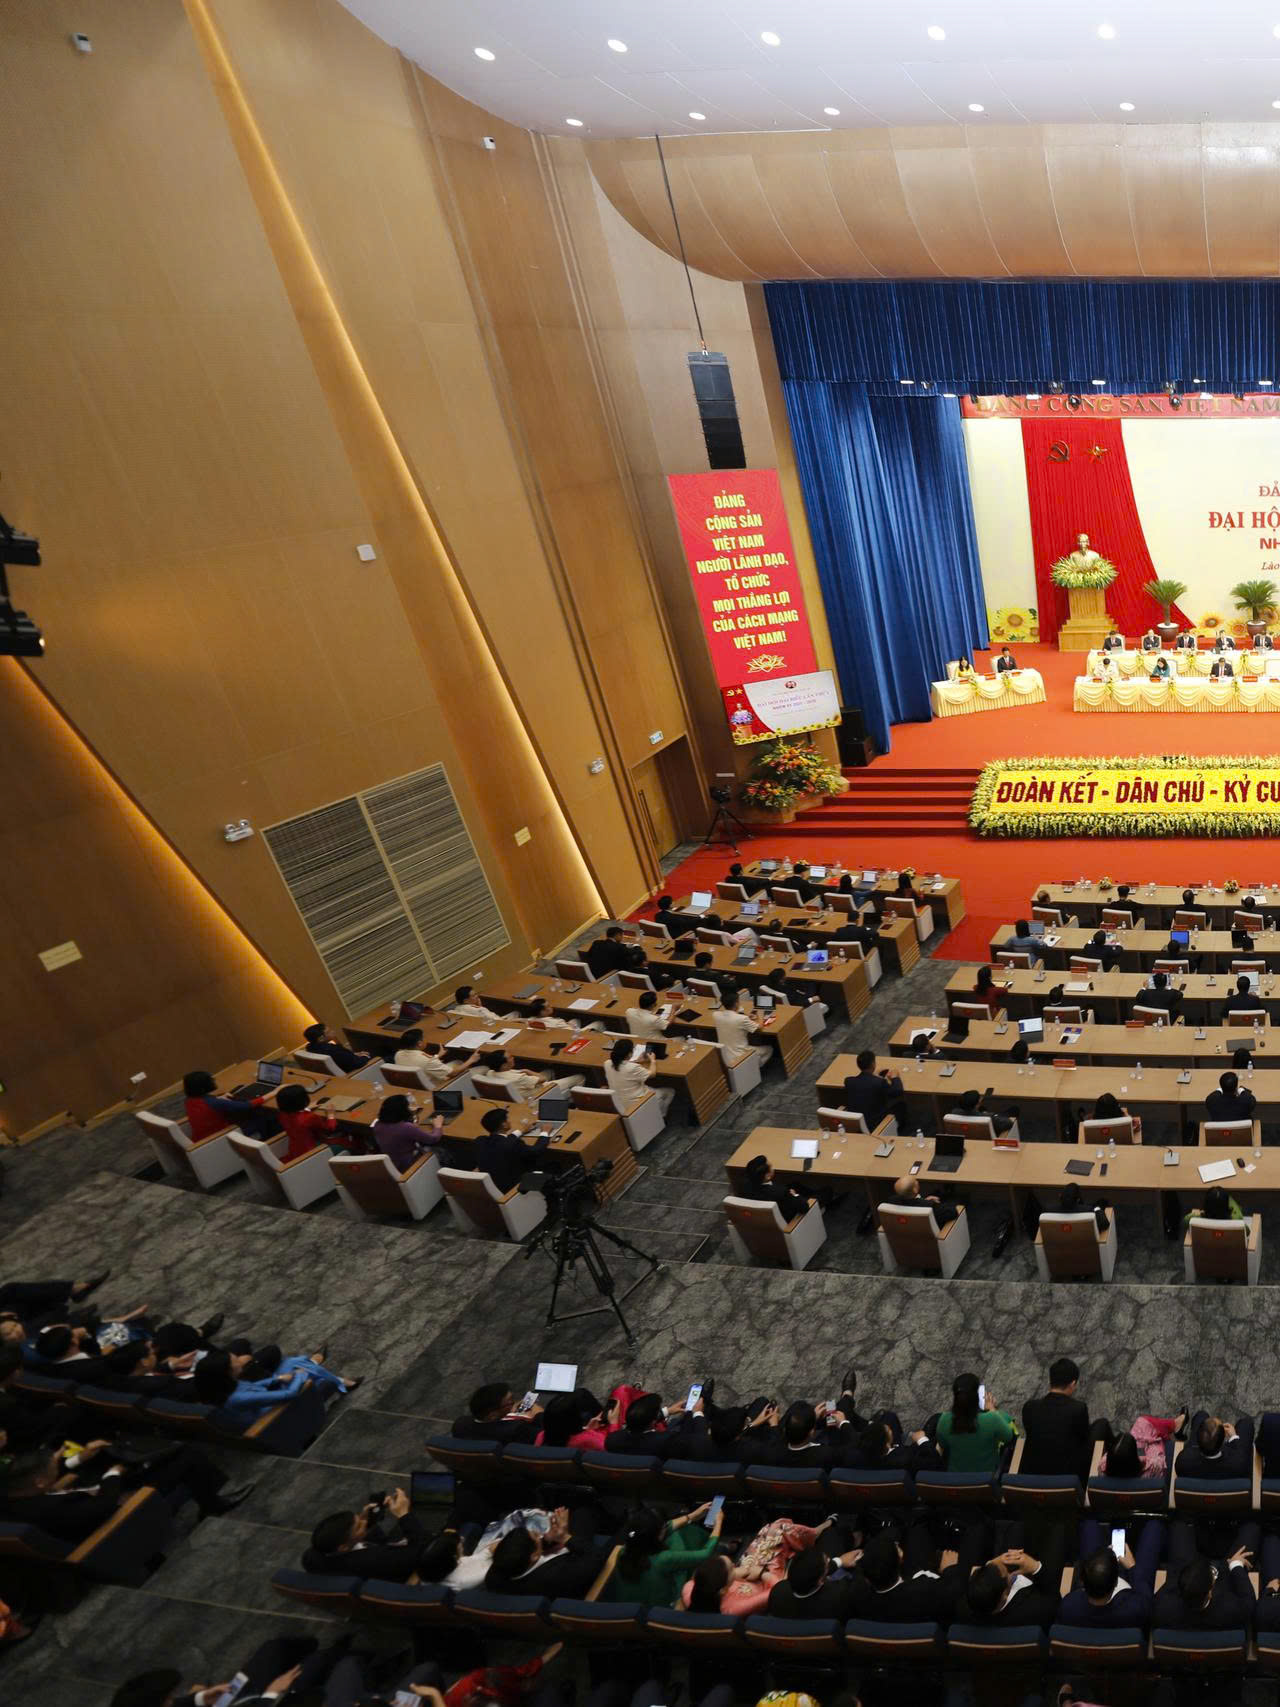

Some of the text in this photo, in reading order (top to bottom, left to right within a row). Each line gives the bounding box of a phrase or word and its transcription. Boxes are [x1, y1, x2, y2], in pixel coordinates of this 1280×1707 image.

[713, 489, 746, 508] ĐẢNG
[706, 509, 762, 533] CỘNG SẢN
[1208, 512, 1244, 531] ĐẠI
[712, 534, 765, 553] VIỆT NAM
[696, 552, 789, 574] NGƯỜI LÃNH ĐẠO,
[1261, 561, 1280, 570] Lào
[724, 571, 770, 590] TỔ CHỨC
[712, 590, 790, 614] MỌI THẮNG LỢI
[712, 610, 799, 632] CỦA CÁCH MẠNG
[734, 630, 787, 650] VIỆT NAM!
[996, 776, 1056, 803] ĐOÀN
[1059, 772, 1098, 803] KẾT
[1116, 776, 1158, 803] DÂN
[1164, 774, 1204, 802] CHỦ
[1224, 774, 1251, 802] KỶ
